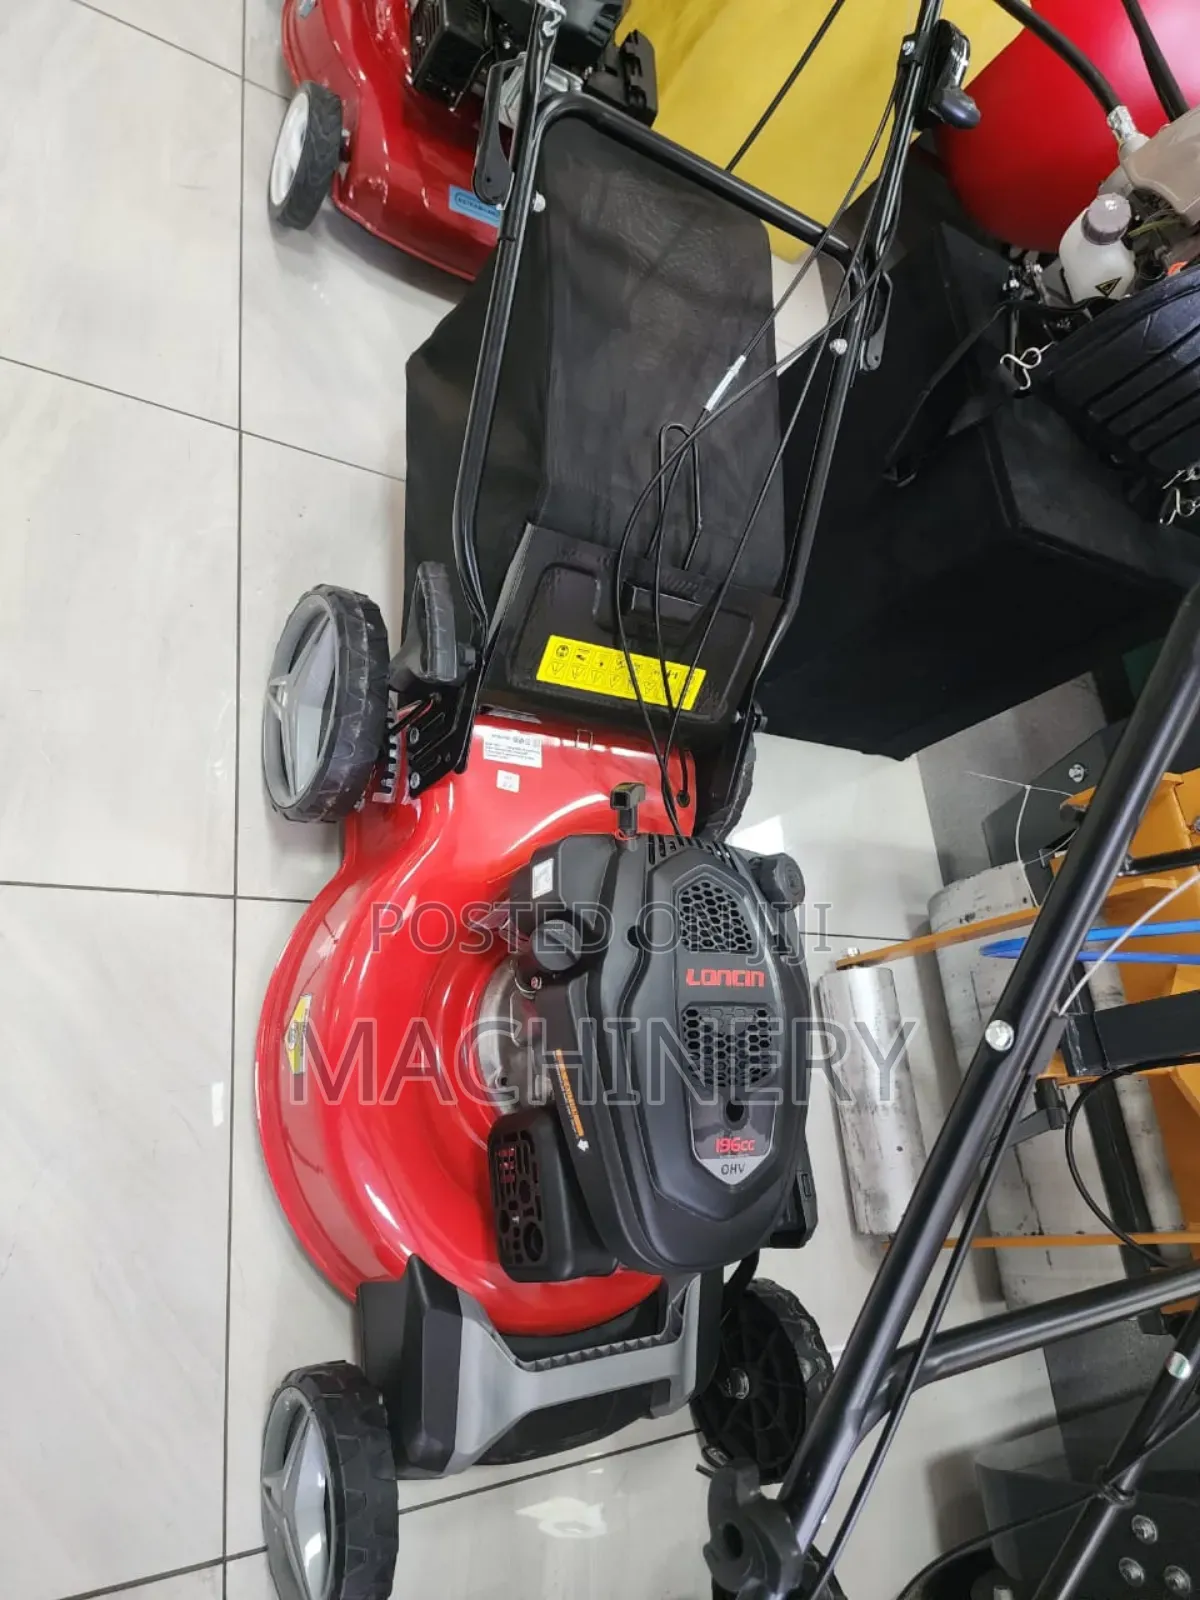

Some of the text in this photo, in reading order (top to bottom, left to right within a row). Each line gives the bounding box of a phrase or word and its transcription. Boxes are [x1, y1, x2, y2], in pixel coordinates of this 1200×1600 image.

[686, 968, 765, 988] LONCIN
[715, 1137, 756, 1154] 196cc
[721, 1163, 746, 1176] OHV
